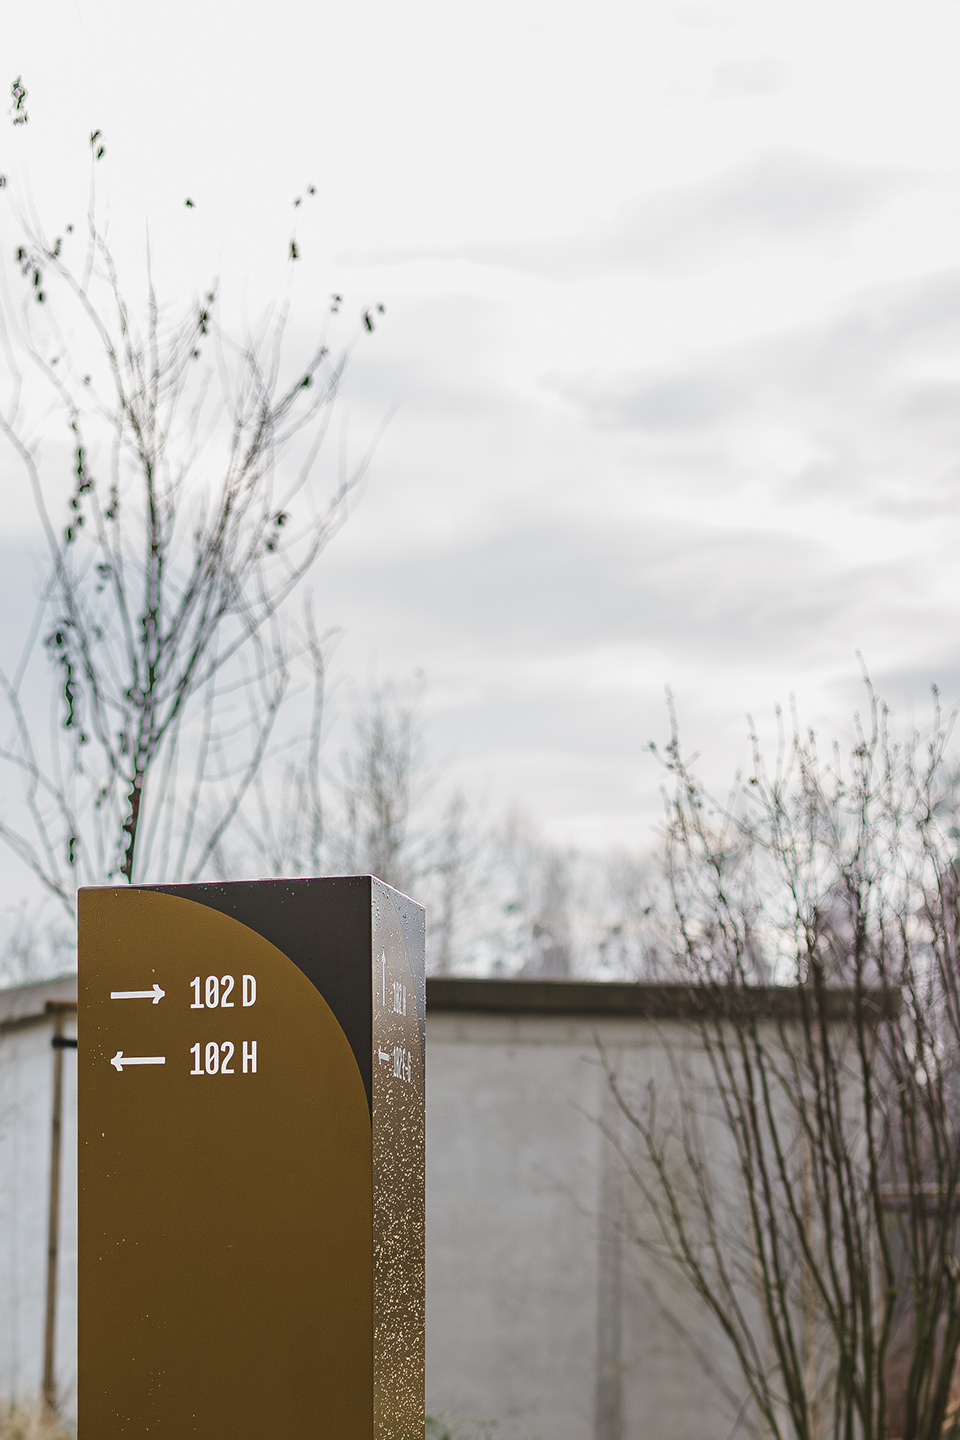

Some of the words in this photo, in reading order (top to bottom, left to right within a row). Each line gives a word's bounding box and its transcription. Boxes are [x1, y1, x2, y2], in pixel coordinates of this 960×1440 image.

[189, 974, 235, 1009] 102
[242, 974, 257, 1007] D
[189, 1041, 235, 1076] 102
[242, 1040, 258, 1074] H
